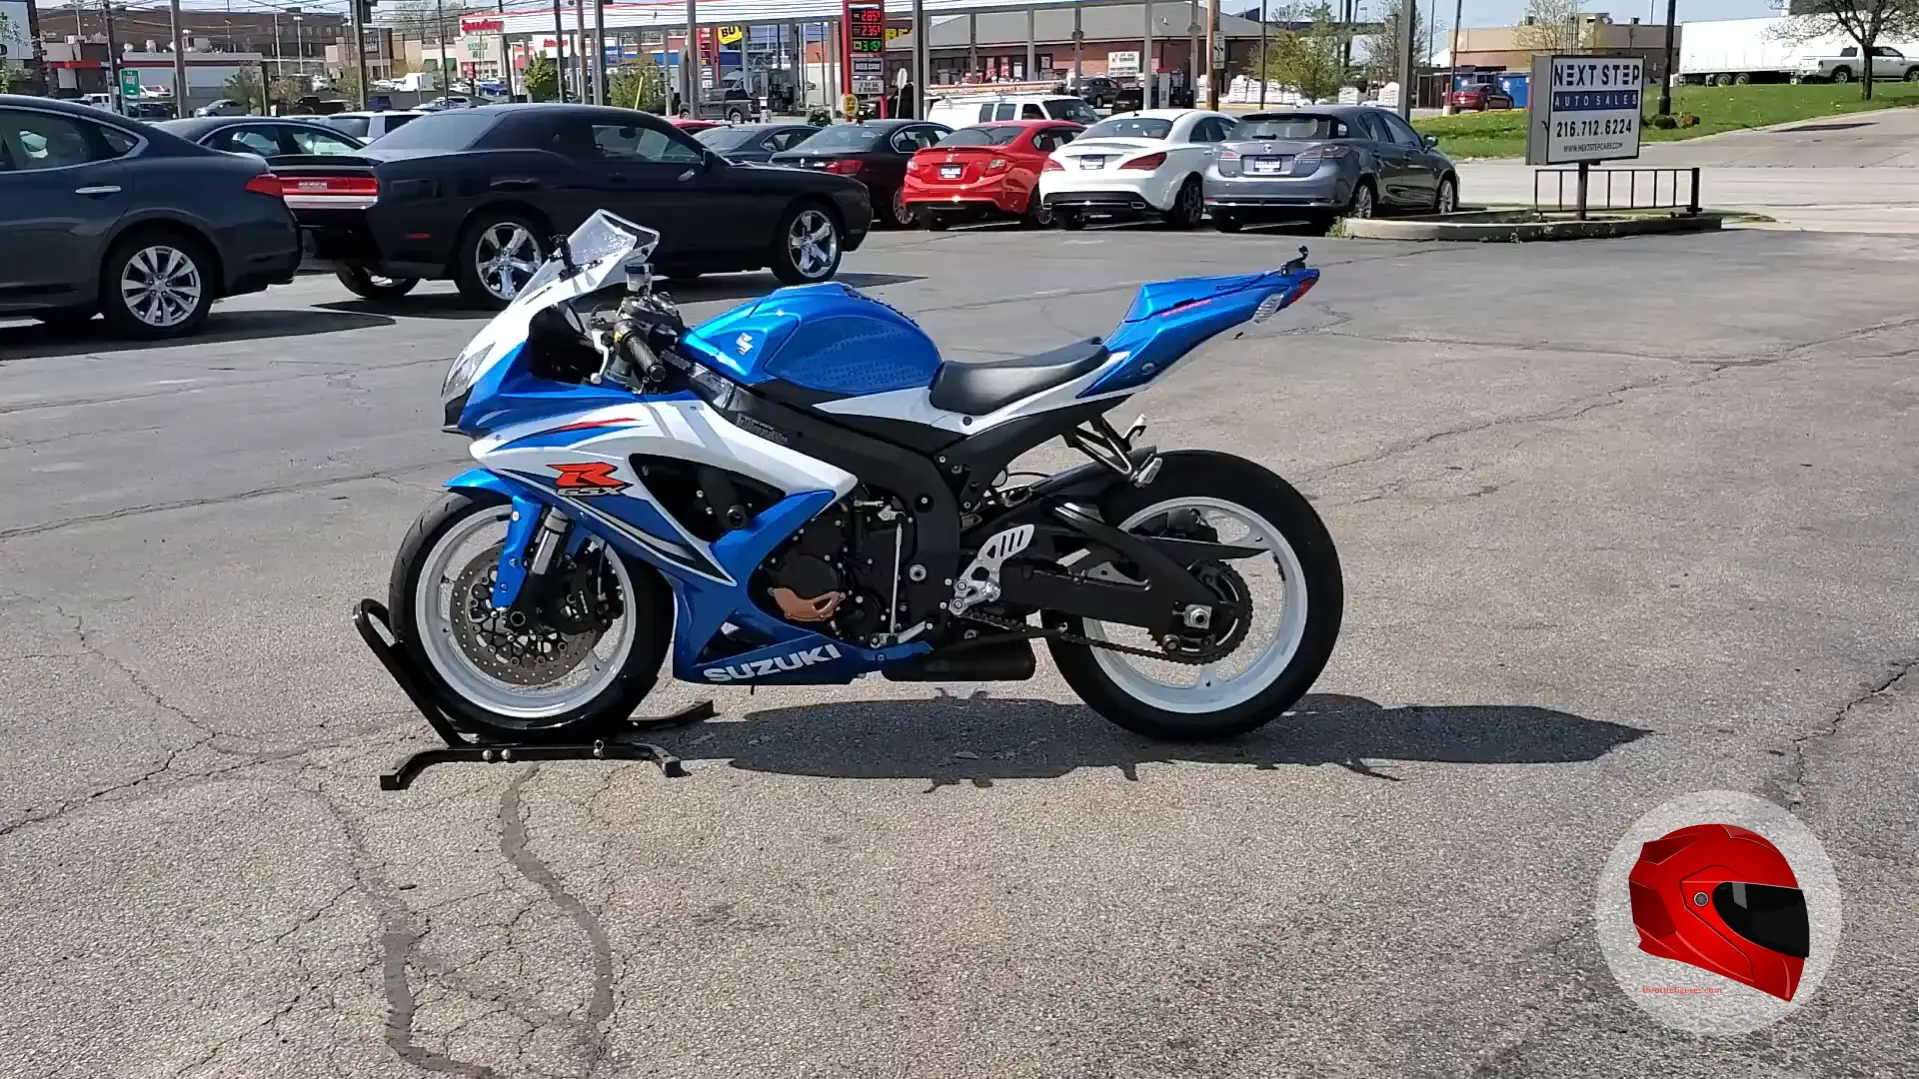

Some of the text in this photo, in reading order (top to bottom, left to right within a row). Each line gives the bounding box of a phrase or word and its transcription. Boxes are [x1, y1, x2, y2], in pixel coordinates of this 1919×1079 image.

[1553, 64, 1640, 86] NEXT STEP
[1554, 94, 1637, 107] AUTO SALES
[1556, 118, 1632, 138] 216.712.6224
[703, 643, 842, 682] SUZUKI
